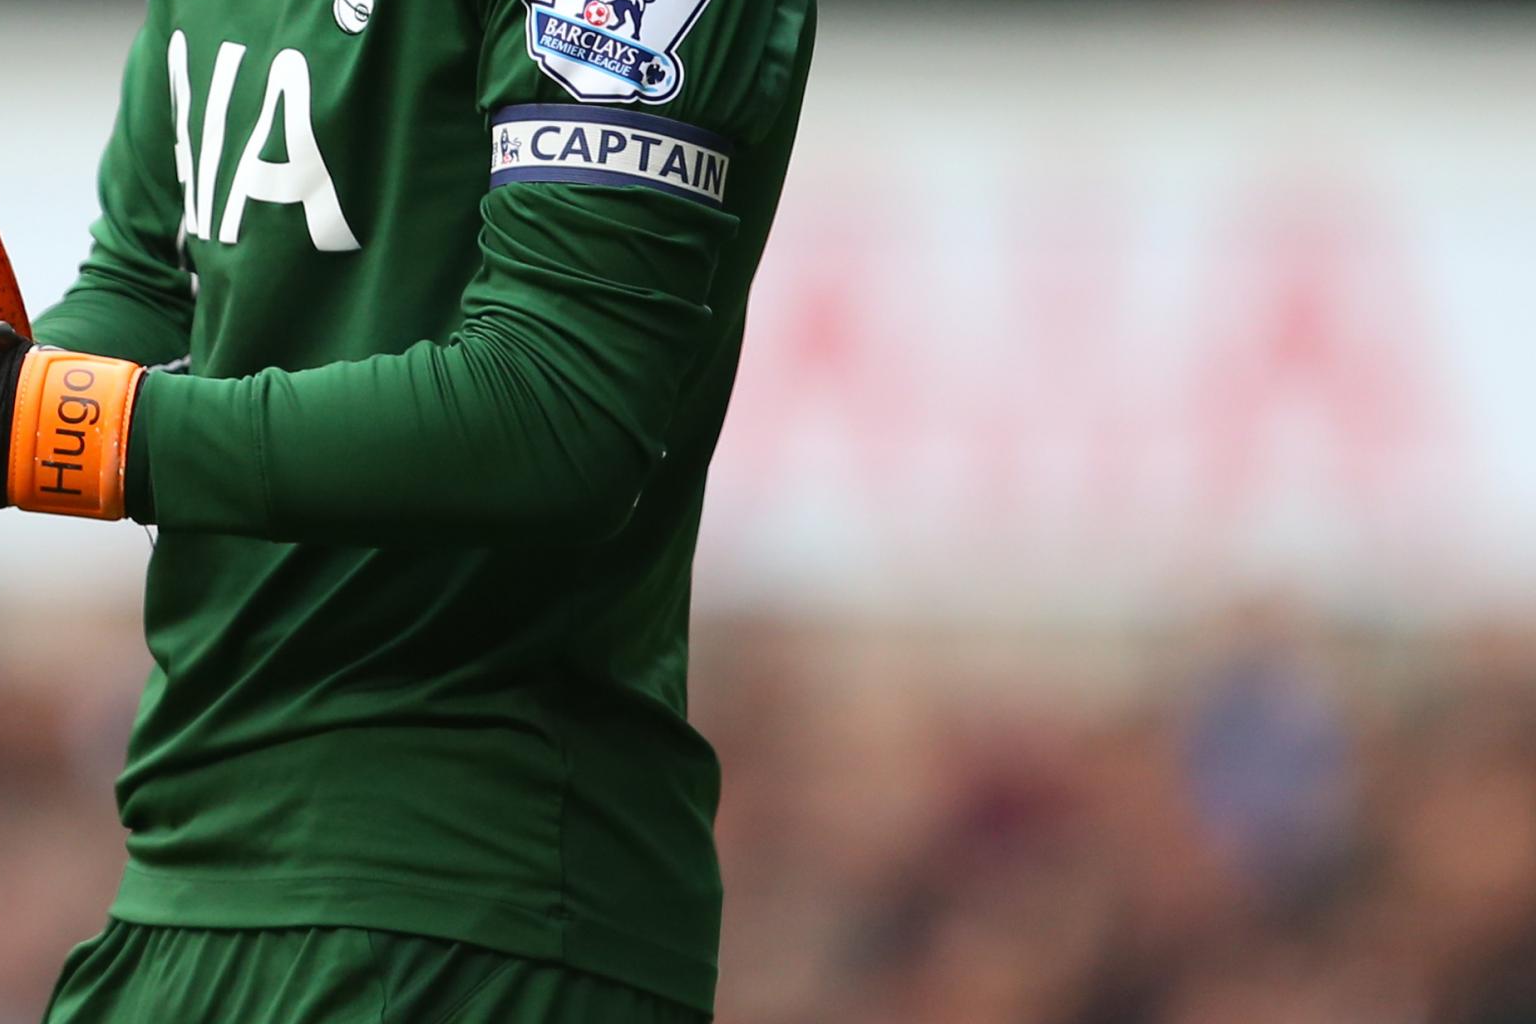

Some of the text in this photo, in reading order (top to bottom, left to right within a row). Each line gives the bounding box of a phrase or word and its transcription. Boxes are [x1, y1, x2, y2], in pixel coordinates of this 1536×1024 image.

[540, 35, 632, 77] PREMIER LEAGUE
[545, 18, 639, 65] BARCLAYS
[531, 125, 725, 196] CAPTAIN
[39, 368, 100, 495] Hugo
